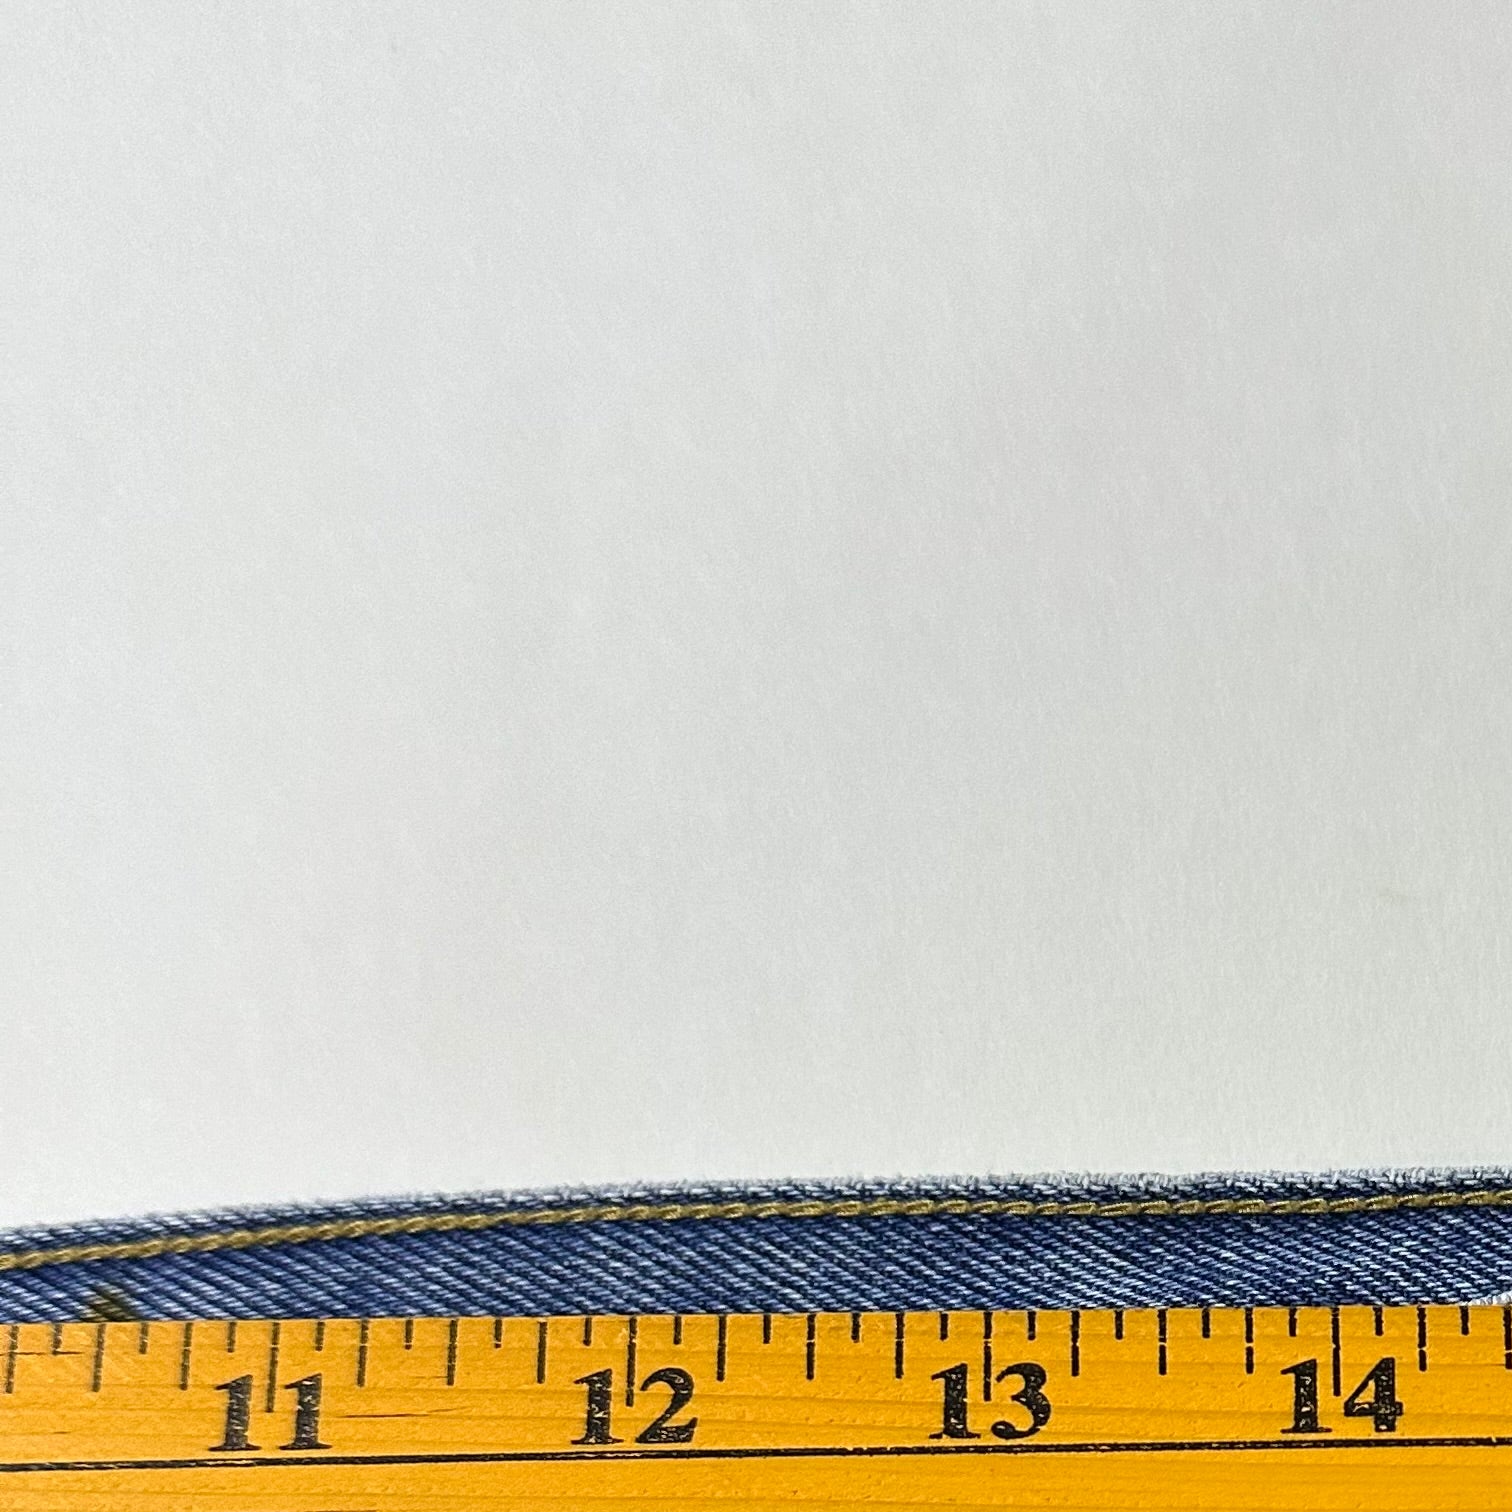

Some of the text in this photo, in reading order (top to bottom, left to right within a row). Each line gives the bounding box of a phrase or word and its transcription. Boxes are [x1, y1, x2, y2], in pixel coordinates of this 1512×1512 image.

[208, 1374, 331, 1451] 11
[571, 1368, 697, 1445] 12
[929, 1362, 1051, 1440] 13
[1280, 1357, 1404, 1434] 14
